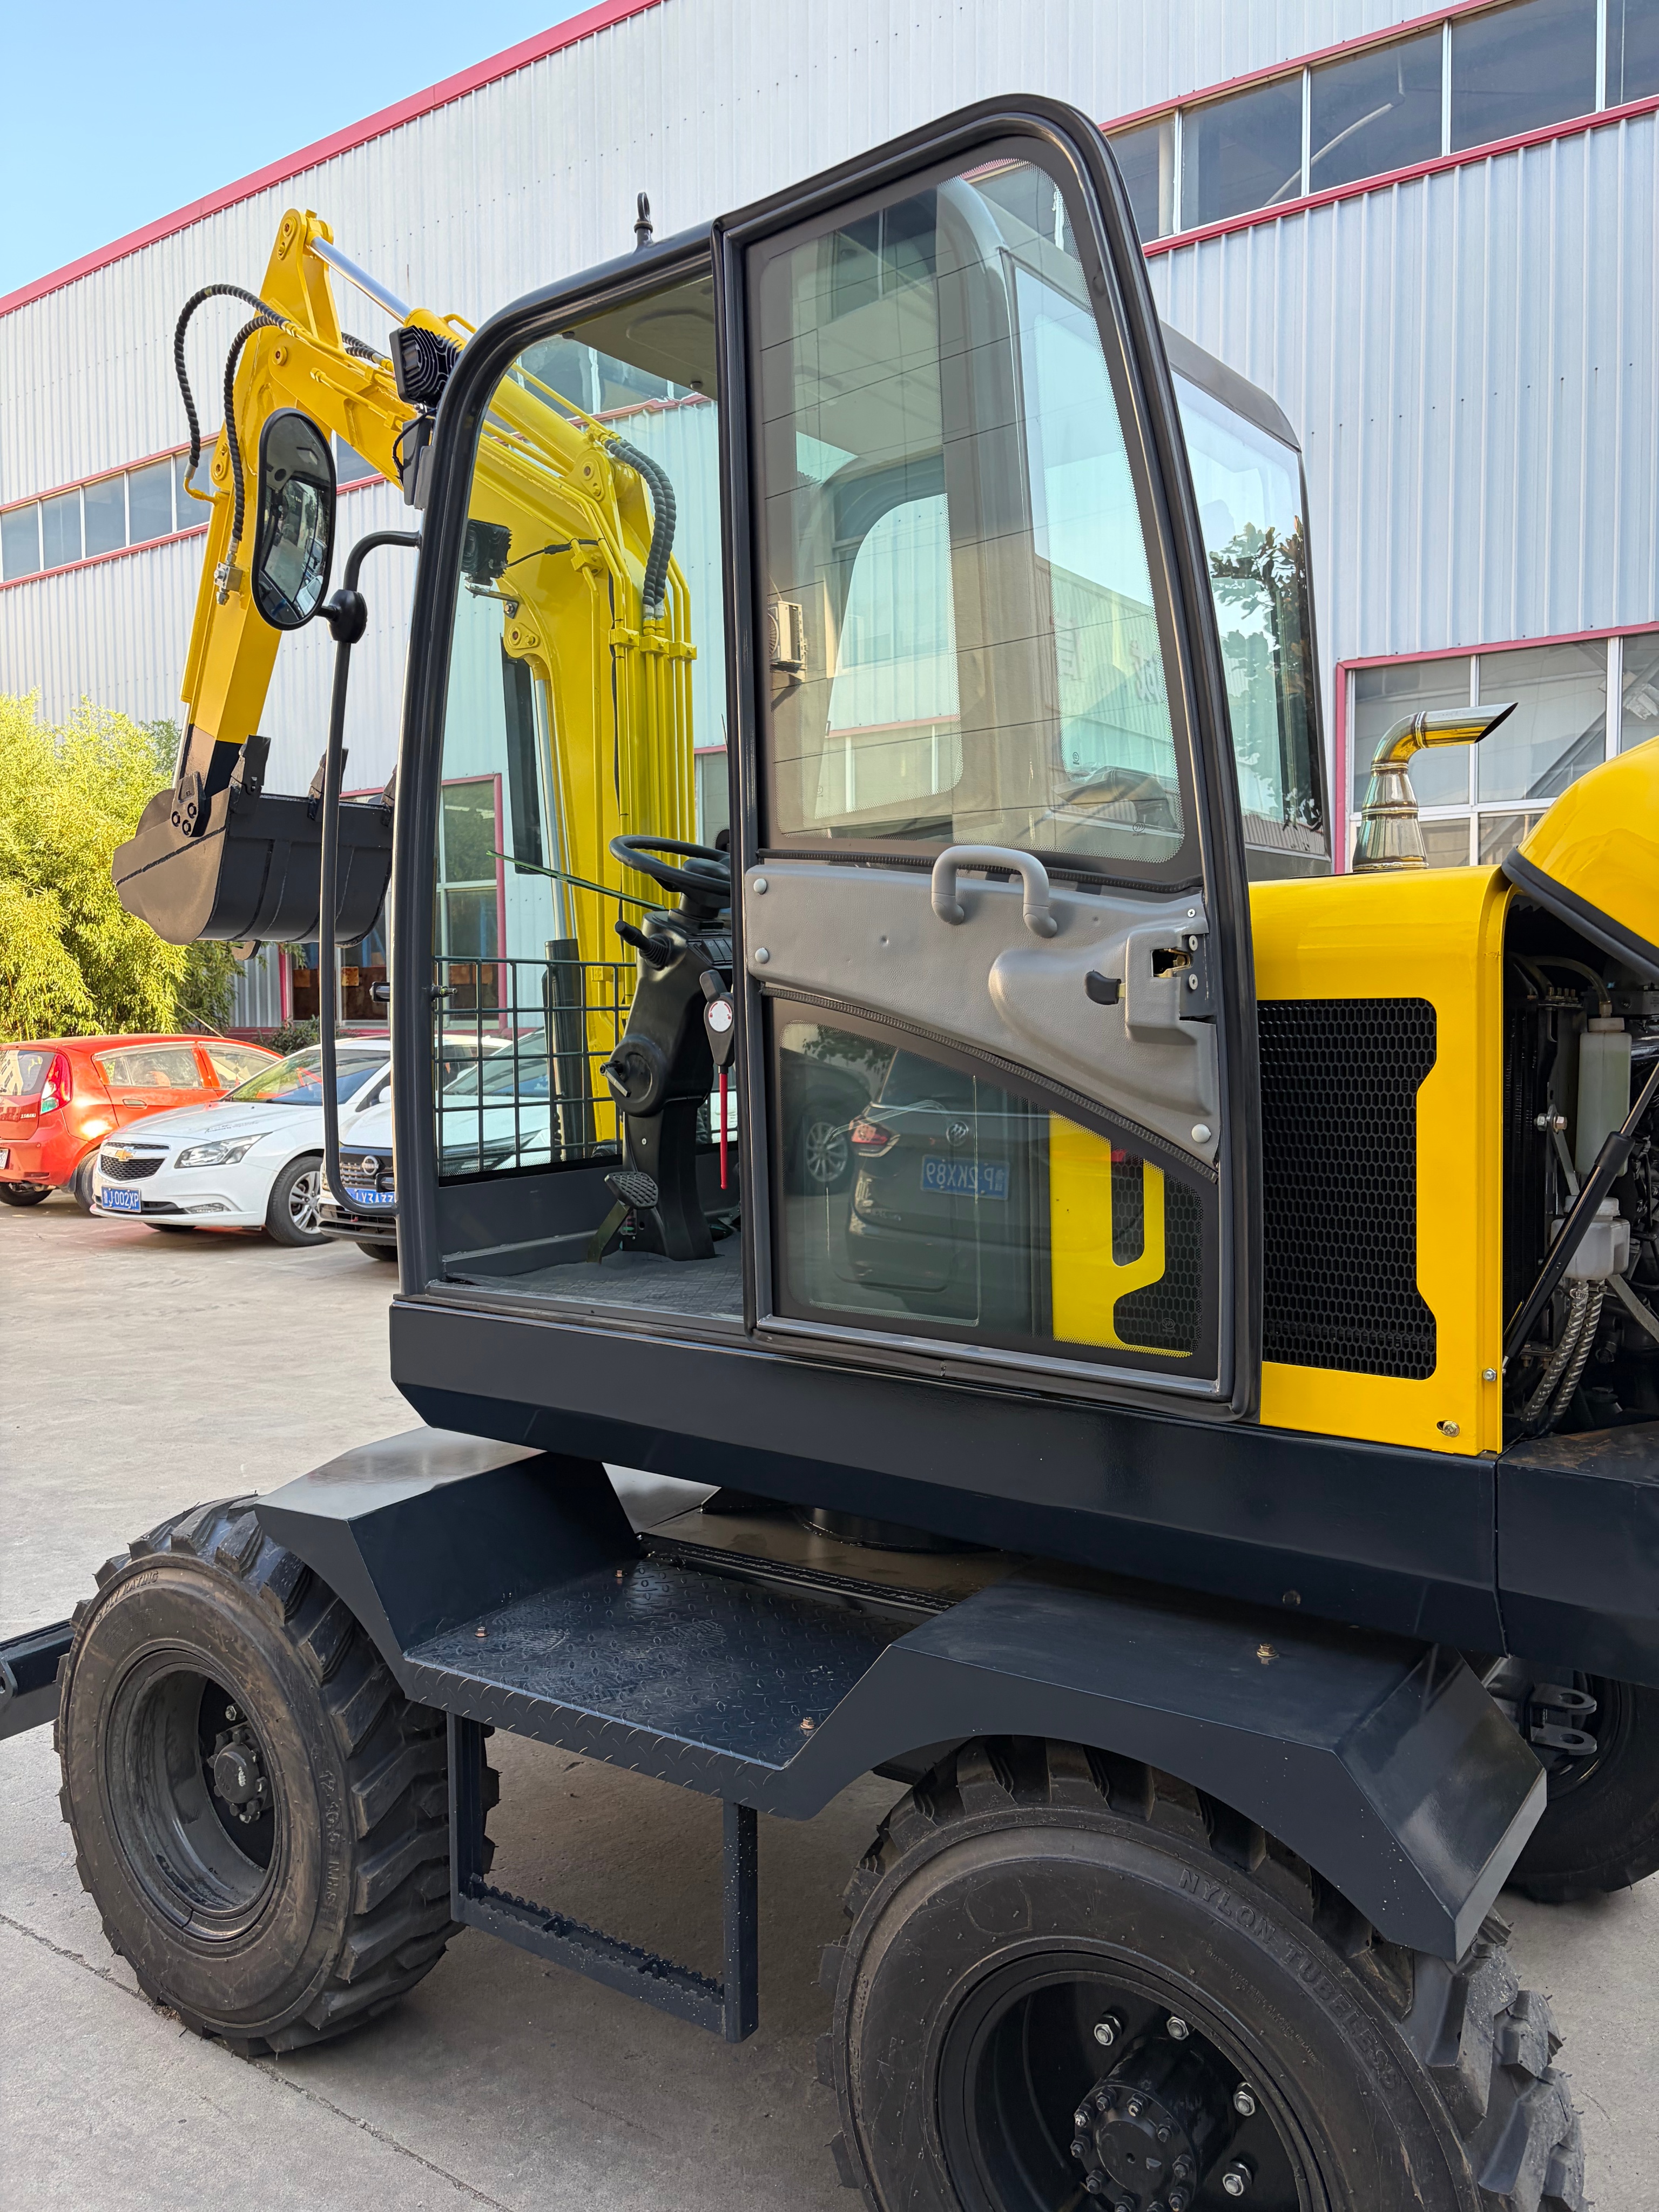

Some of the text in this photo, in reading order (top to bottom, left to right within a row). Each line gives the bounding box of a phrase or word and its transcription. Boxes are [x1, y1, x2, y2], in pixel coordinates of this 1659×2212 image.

[123, 1570, 159, 1596] RATING
[1178, 1868, 1276, 1945] NYLON
[1280, 1941, 1397, 2090] TUBELESS
